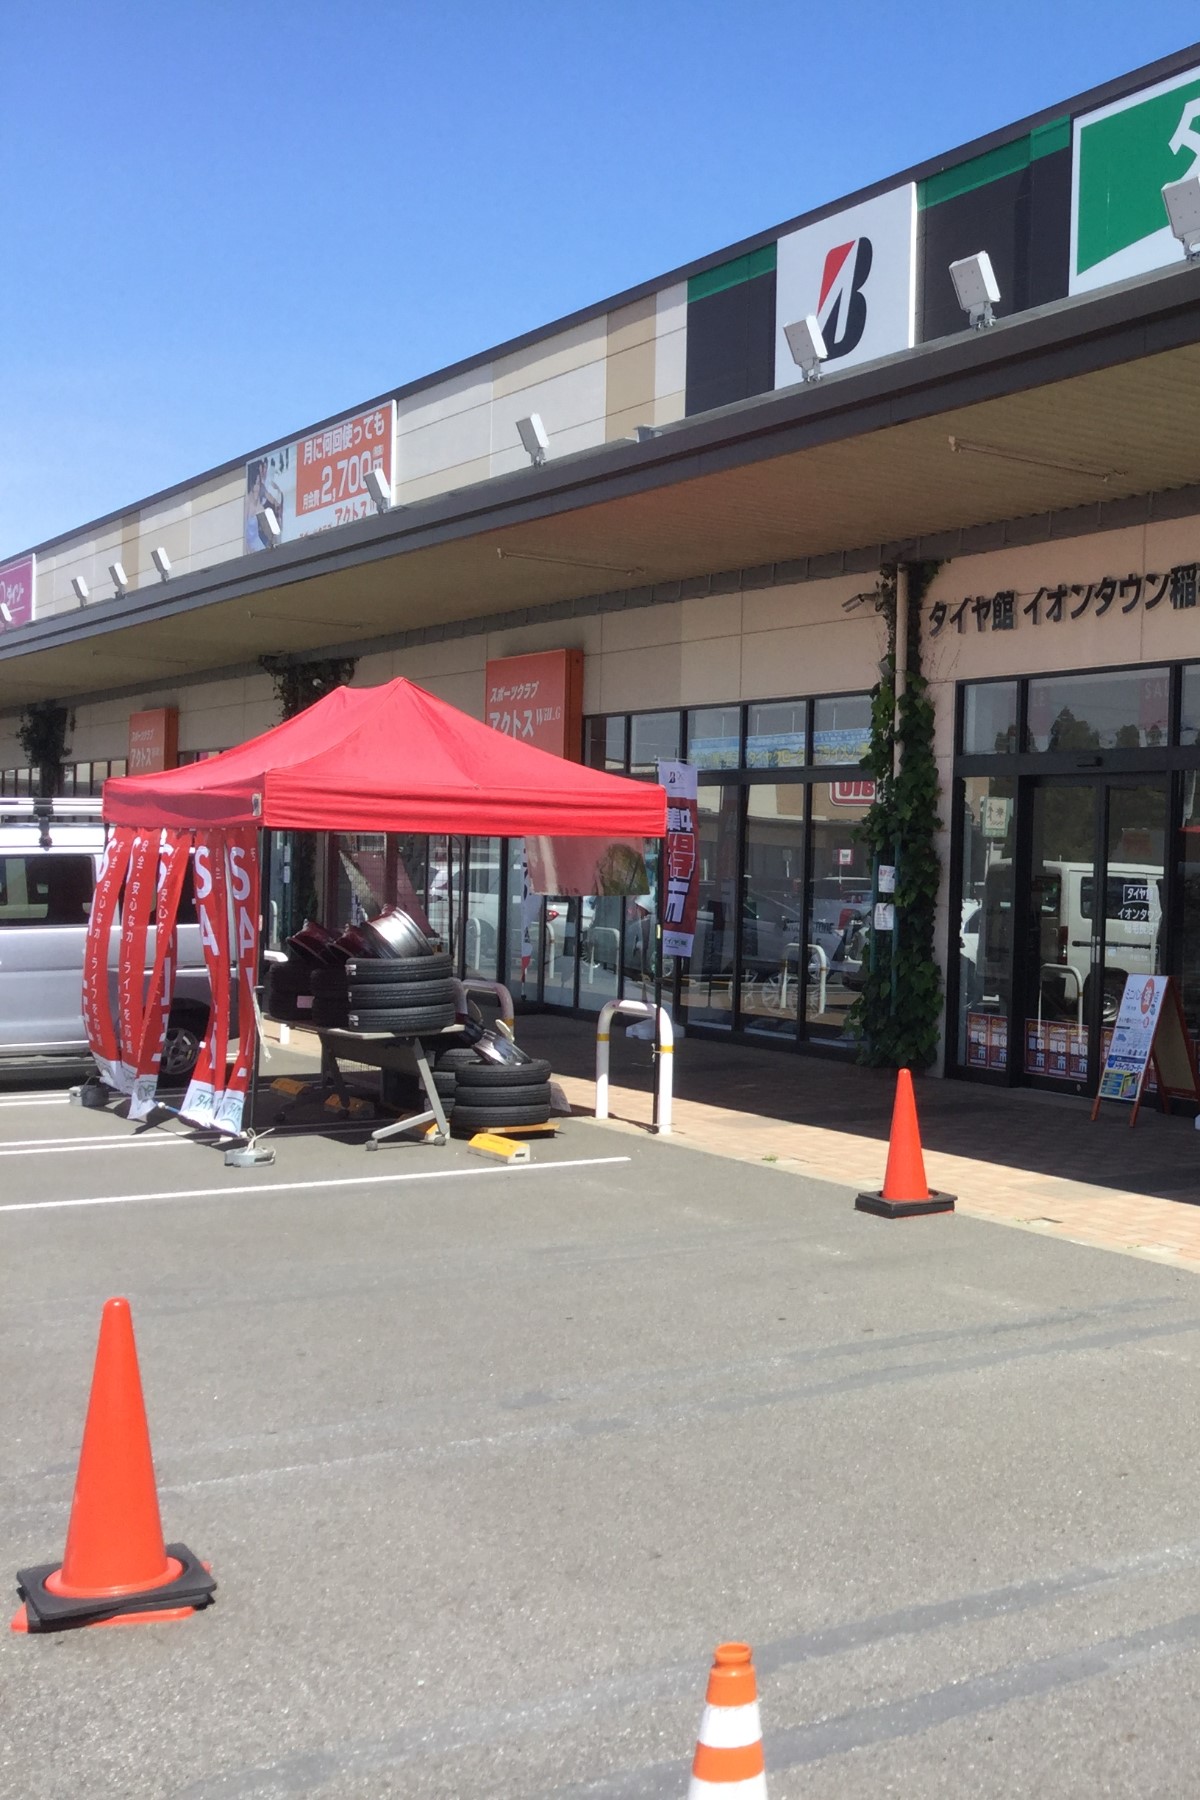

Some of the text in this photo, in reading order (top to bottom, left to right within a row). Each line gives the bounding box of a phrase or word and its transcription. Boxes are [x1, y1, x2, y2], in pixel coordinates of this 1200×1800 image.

[303, 411, 385, 466] 月に何回使っても
[928, 589, 1016, 638] タイヤ館
[489, 680, 540, 703] スポーツクラブ
[489, 709, 535, 741] アクトス
